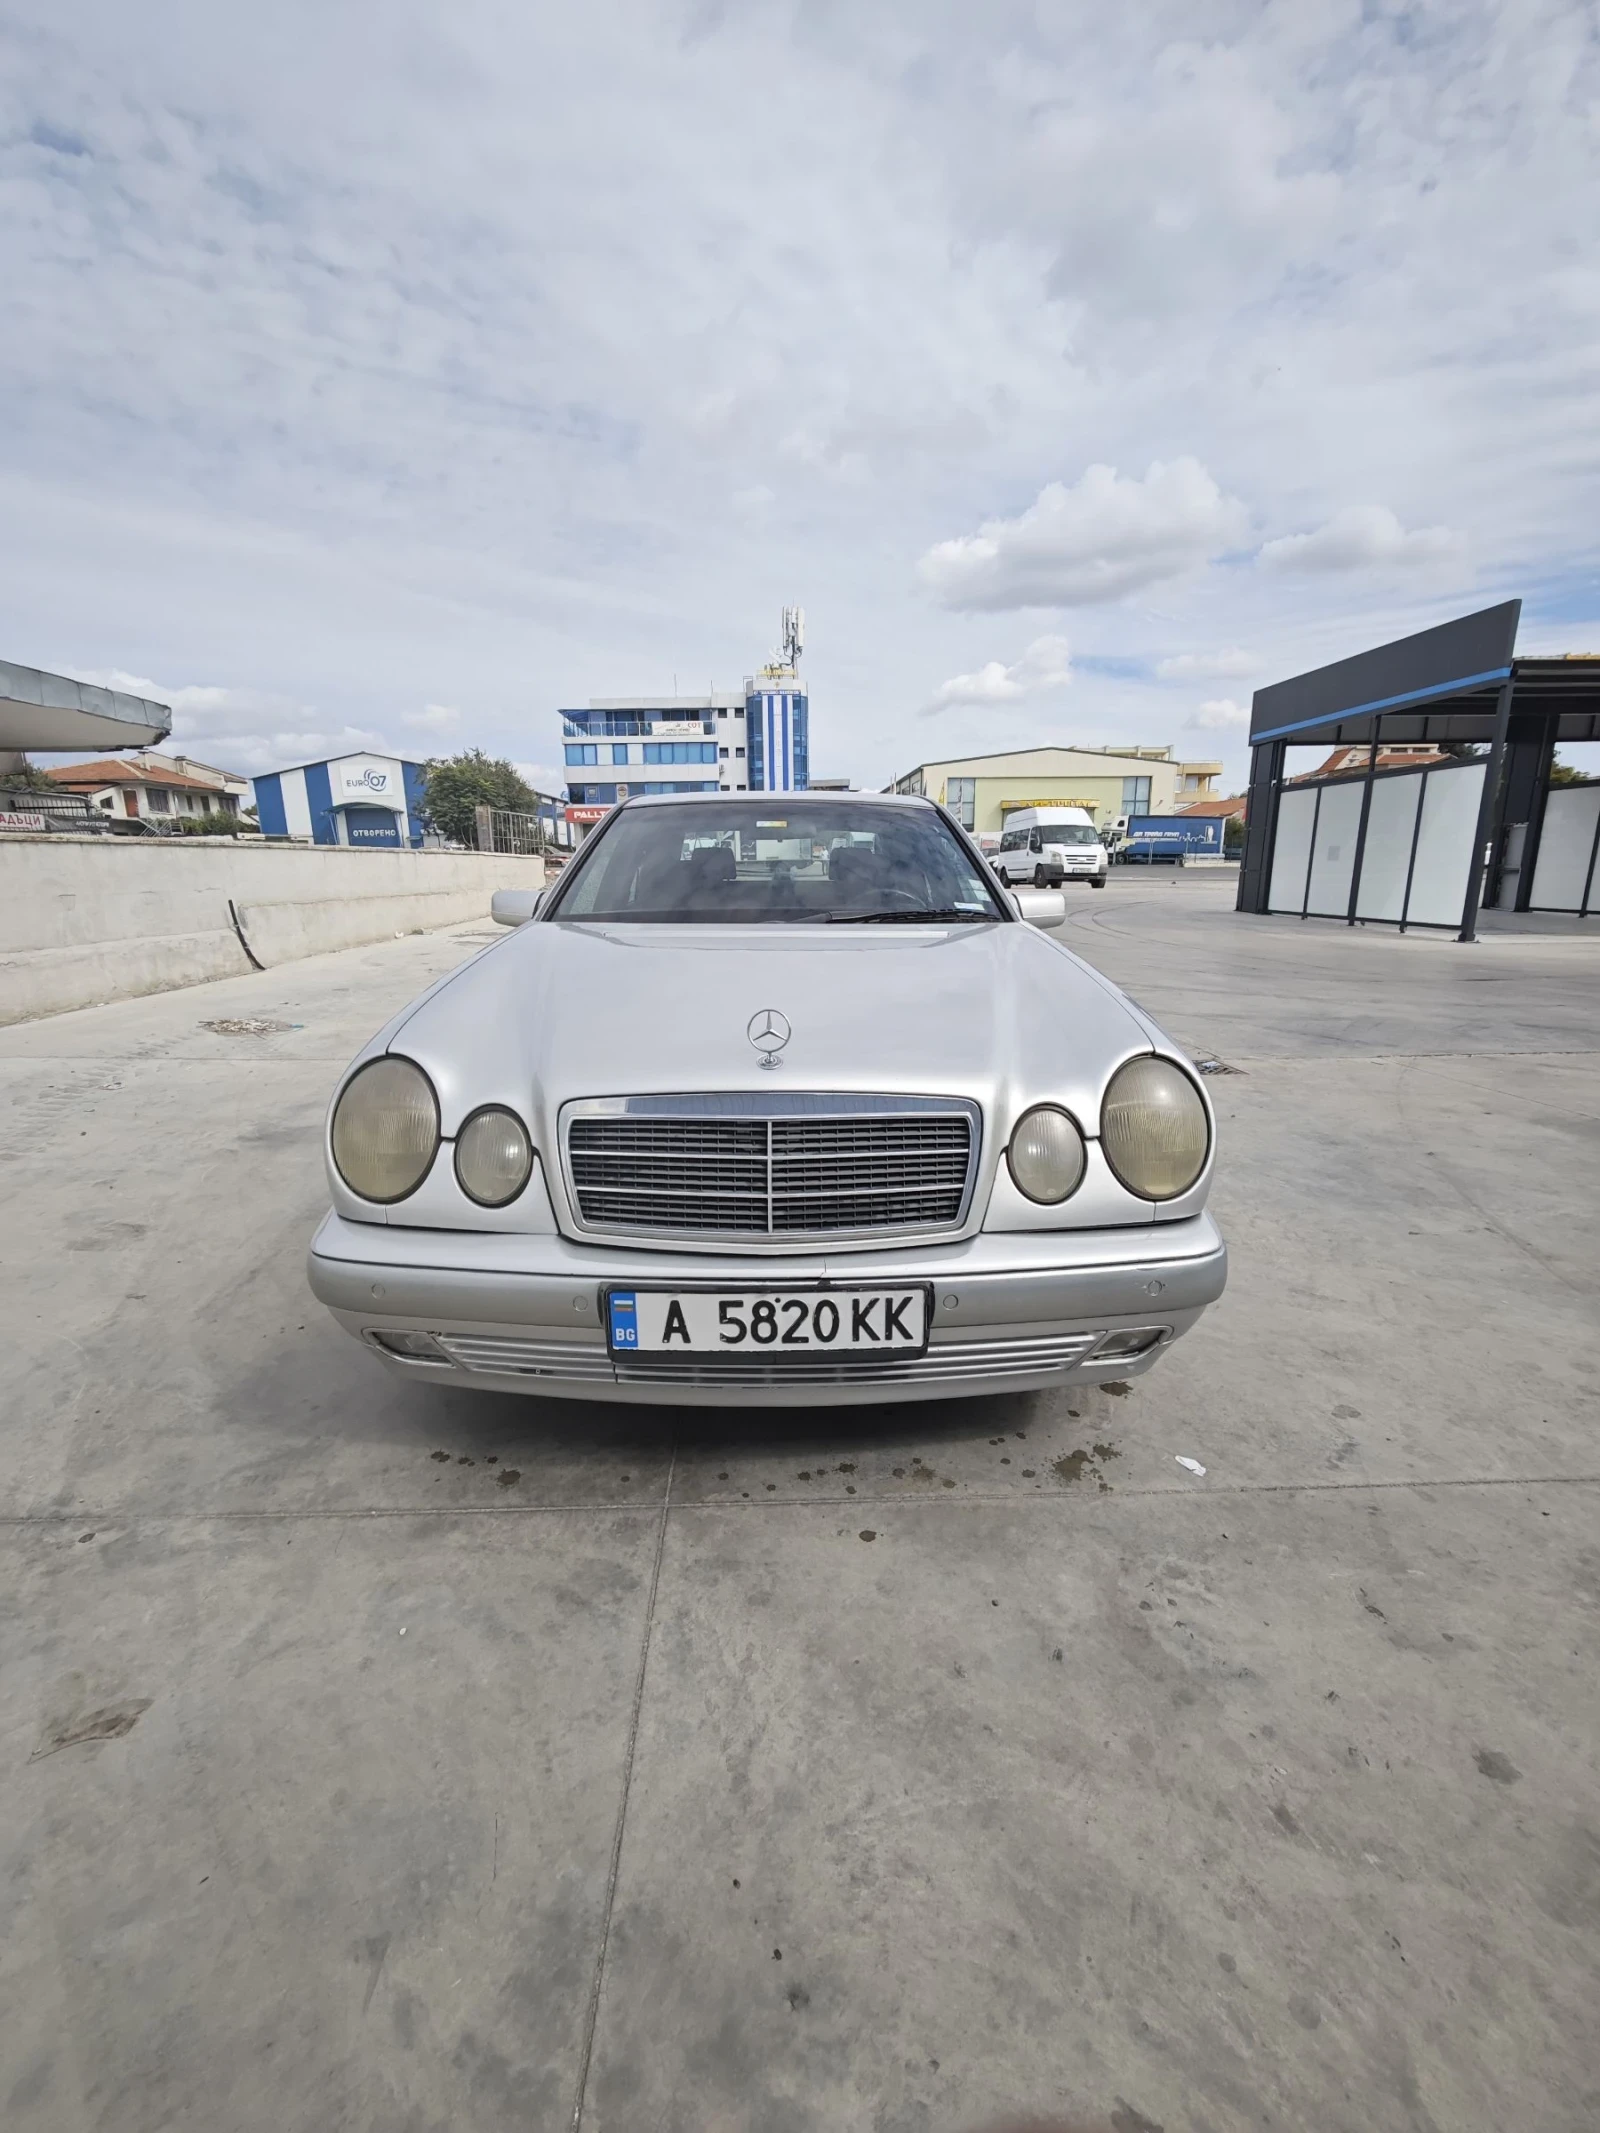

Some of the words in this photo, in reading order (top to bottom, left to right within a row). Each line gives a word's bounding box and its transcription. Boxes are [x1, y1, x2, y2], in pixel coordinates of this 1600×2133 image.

[352, 829, 397, 837] ОТВОРЕНО
[662, 1300, 692, 1344] A
[718, 1299, 841, 1344] 5820
[851, 1296, 914, 1342] KK
[615, 1328, 636, 1341] BG
